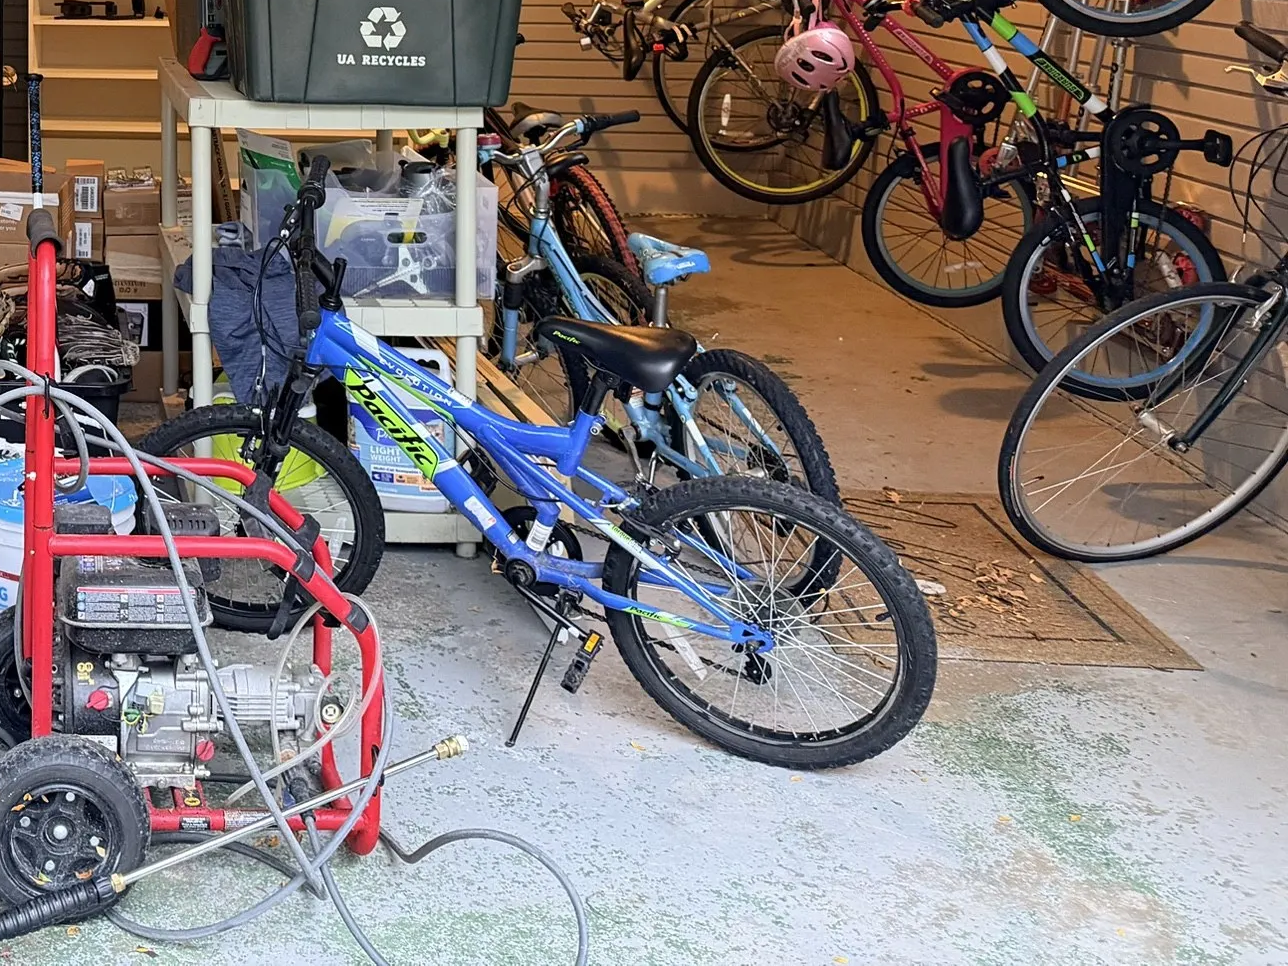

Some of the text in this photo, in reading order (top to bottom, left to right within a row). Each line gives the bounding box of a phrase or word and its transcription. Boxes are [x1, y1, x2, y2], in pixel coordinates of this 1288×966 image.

[336, 53, 426, 67] UA RECYCLES
[378, 359, 452, 407] EVOLUTION
[370, 445, 401, 455] LIGHT
[370, 454, 402, 463] WEIGHT
[630, 606, 663, 620] Pacific
